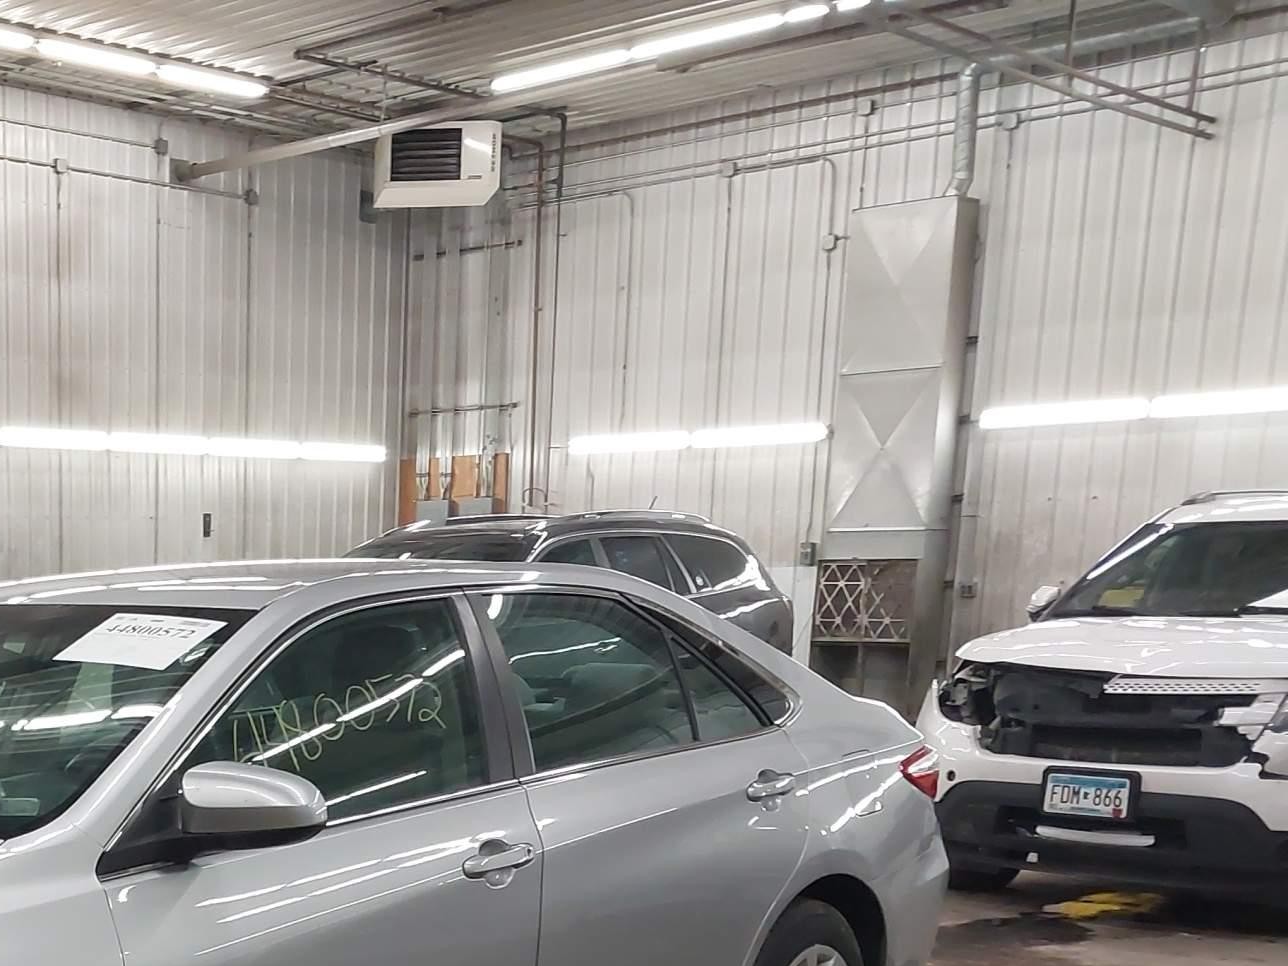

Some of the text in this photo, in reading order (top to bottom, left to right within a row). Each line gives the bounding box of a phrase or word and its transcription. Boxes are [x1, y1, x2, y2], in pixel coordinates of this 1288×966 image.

[106, 623, 197, 640] 44800572
[1049, 784, 1122, 808] FDM 866
